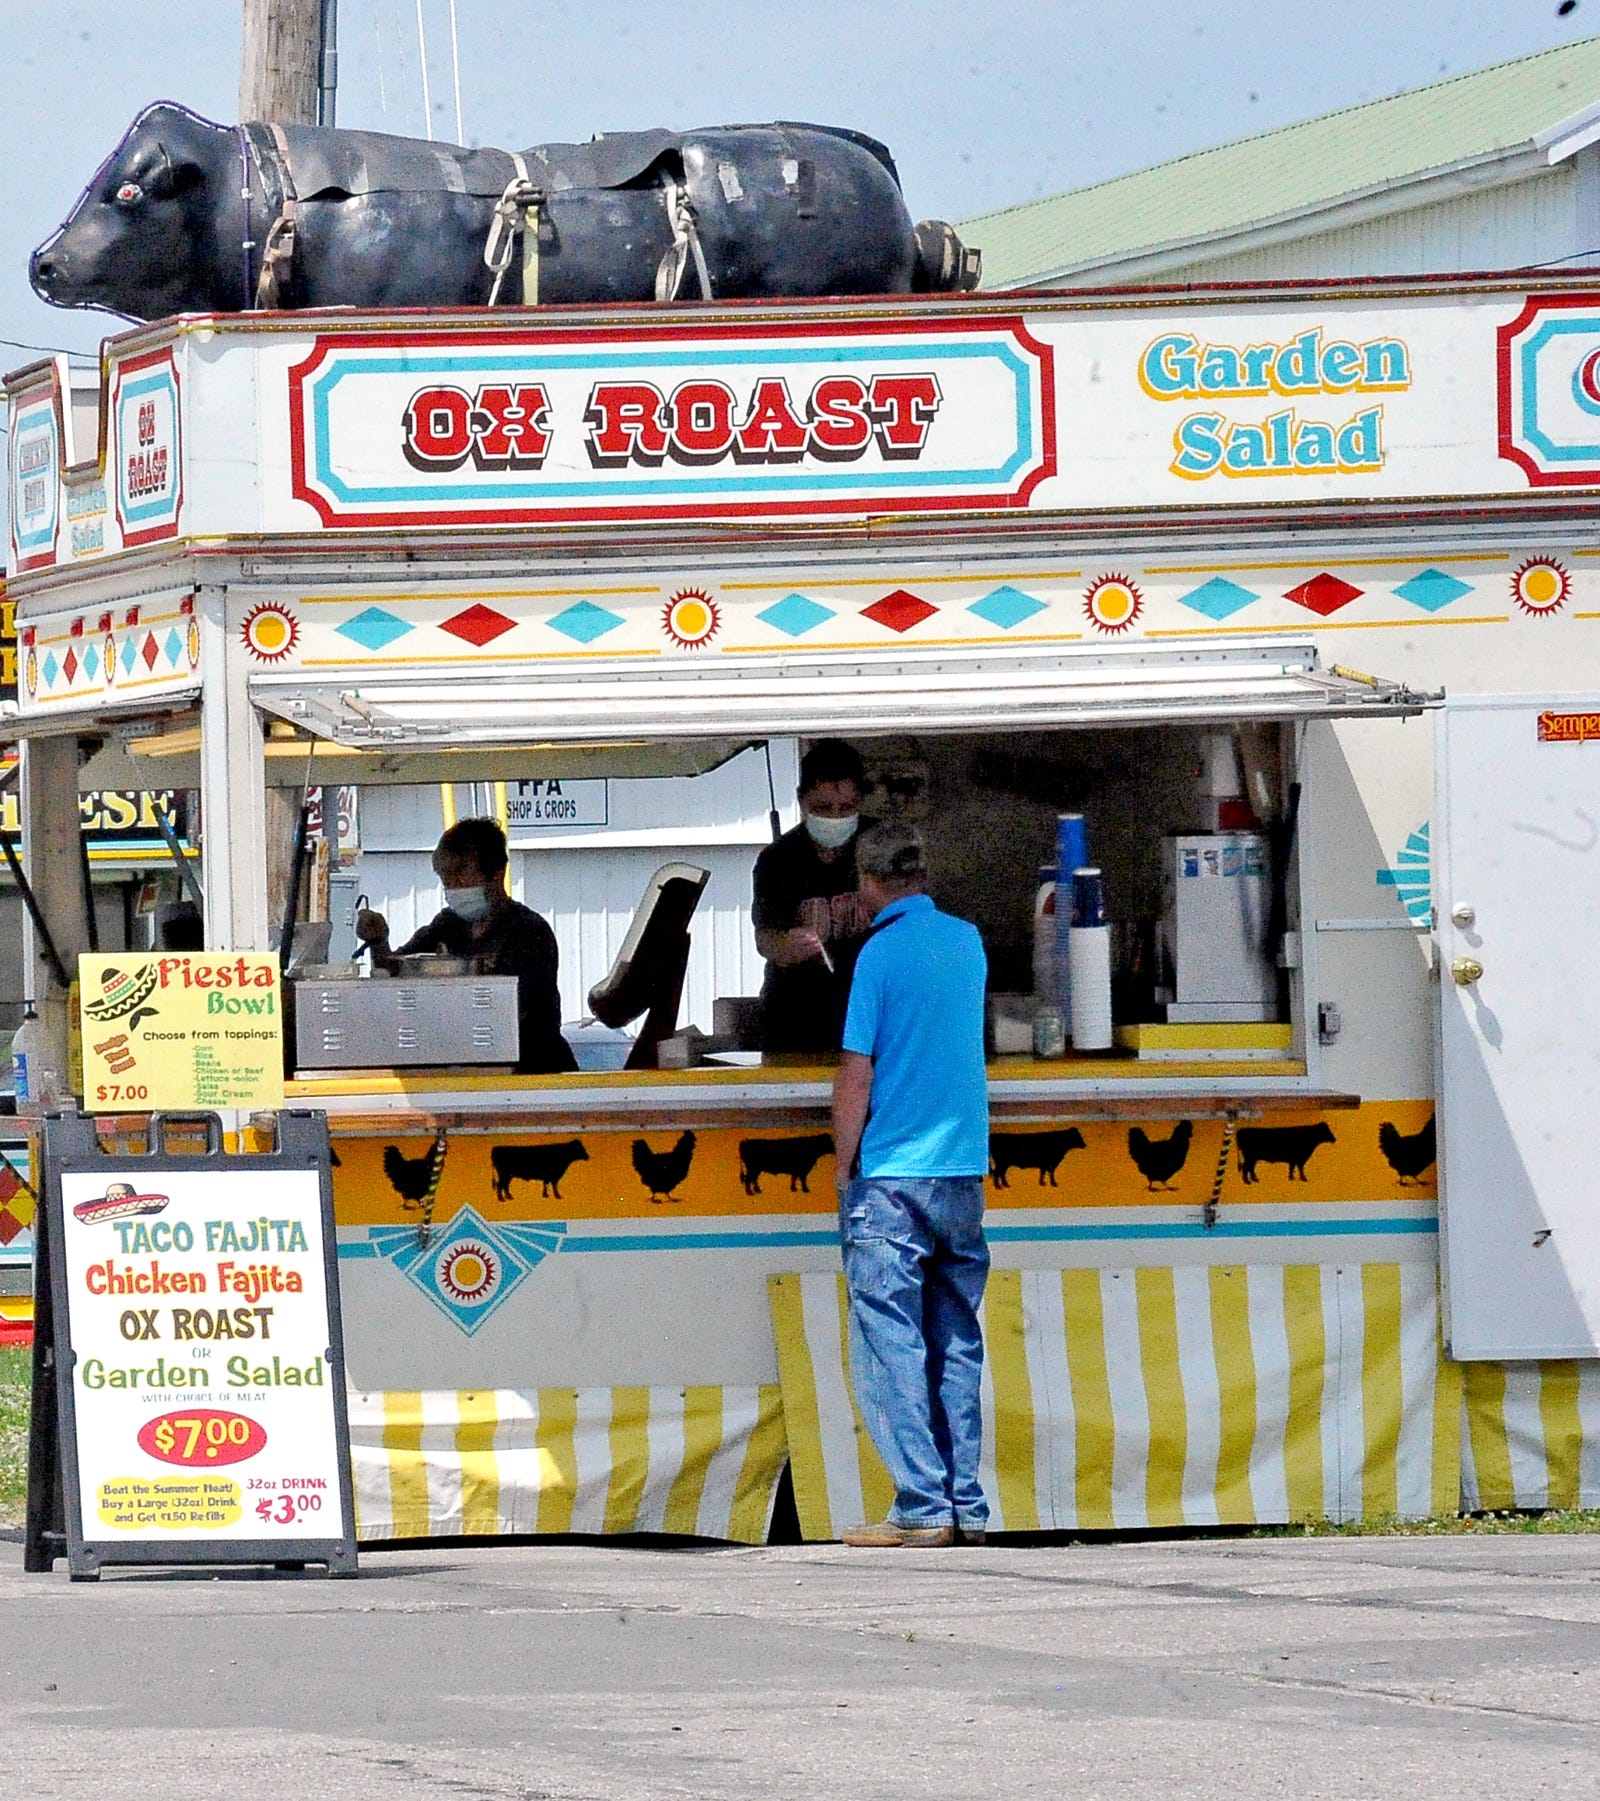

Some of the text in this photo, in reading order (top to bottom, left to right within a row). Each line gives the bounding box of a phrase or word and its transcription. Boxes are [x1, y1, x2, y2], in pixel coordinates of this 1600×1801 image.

[1138, 325, 1412, 401] Garden
[402, 373, 943, 473] OX ROAST
[1169, 403, 1385, 480] Salad
[1541, 711, 1600, 744] Sempe
[506, 801, 532, 819] SHOP
[545, 800, 577, 818] CROPS
[157, 957, 276, 989] Fiesta
[207, 991, 275, 1015] Bowl
[143, 1028, 278, 1041] Choose from toppings:
[97, 1085, 148, 1102] $7.00
[113, 1219, 195, 1254] TACO
[86, 1259, 303, 1303] Chicken Fajita
[120, 1307, 274, 1341] OX ROAST
[192, 1347, 211, 1359] OR
[82, 1354, 324, 1389] Garden Salad
[141, 1392, 266, 1403] WITH CHOICE OF MEAT
[155, 1417, 250, 1459] $7.00
[104, 1483, 232, 1494] Beat the Summer Heat!
[247, 1478, 327, 1490] 32oz DRINK
[102, 1499, 123, 1509] Buy
[137, 1498, 168, 1509] Large
[208, 1497, 237, 1507] Drink
[114, 1512, 133, 1522] and
[137, 1512, 156, 1522] Get
[255, 1494, 322, 1523] $3.00
